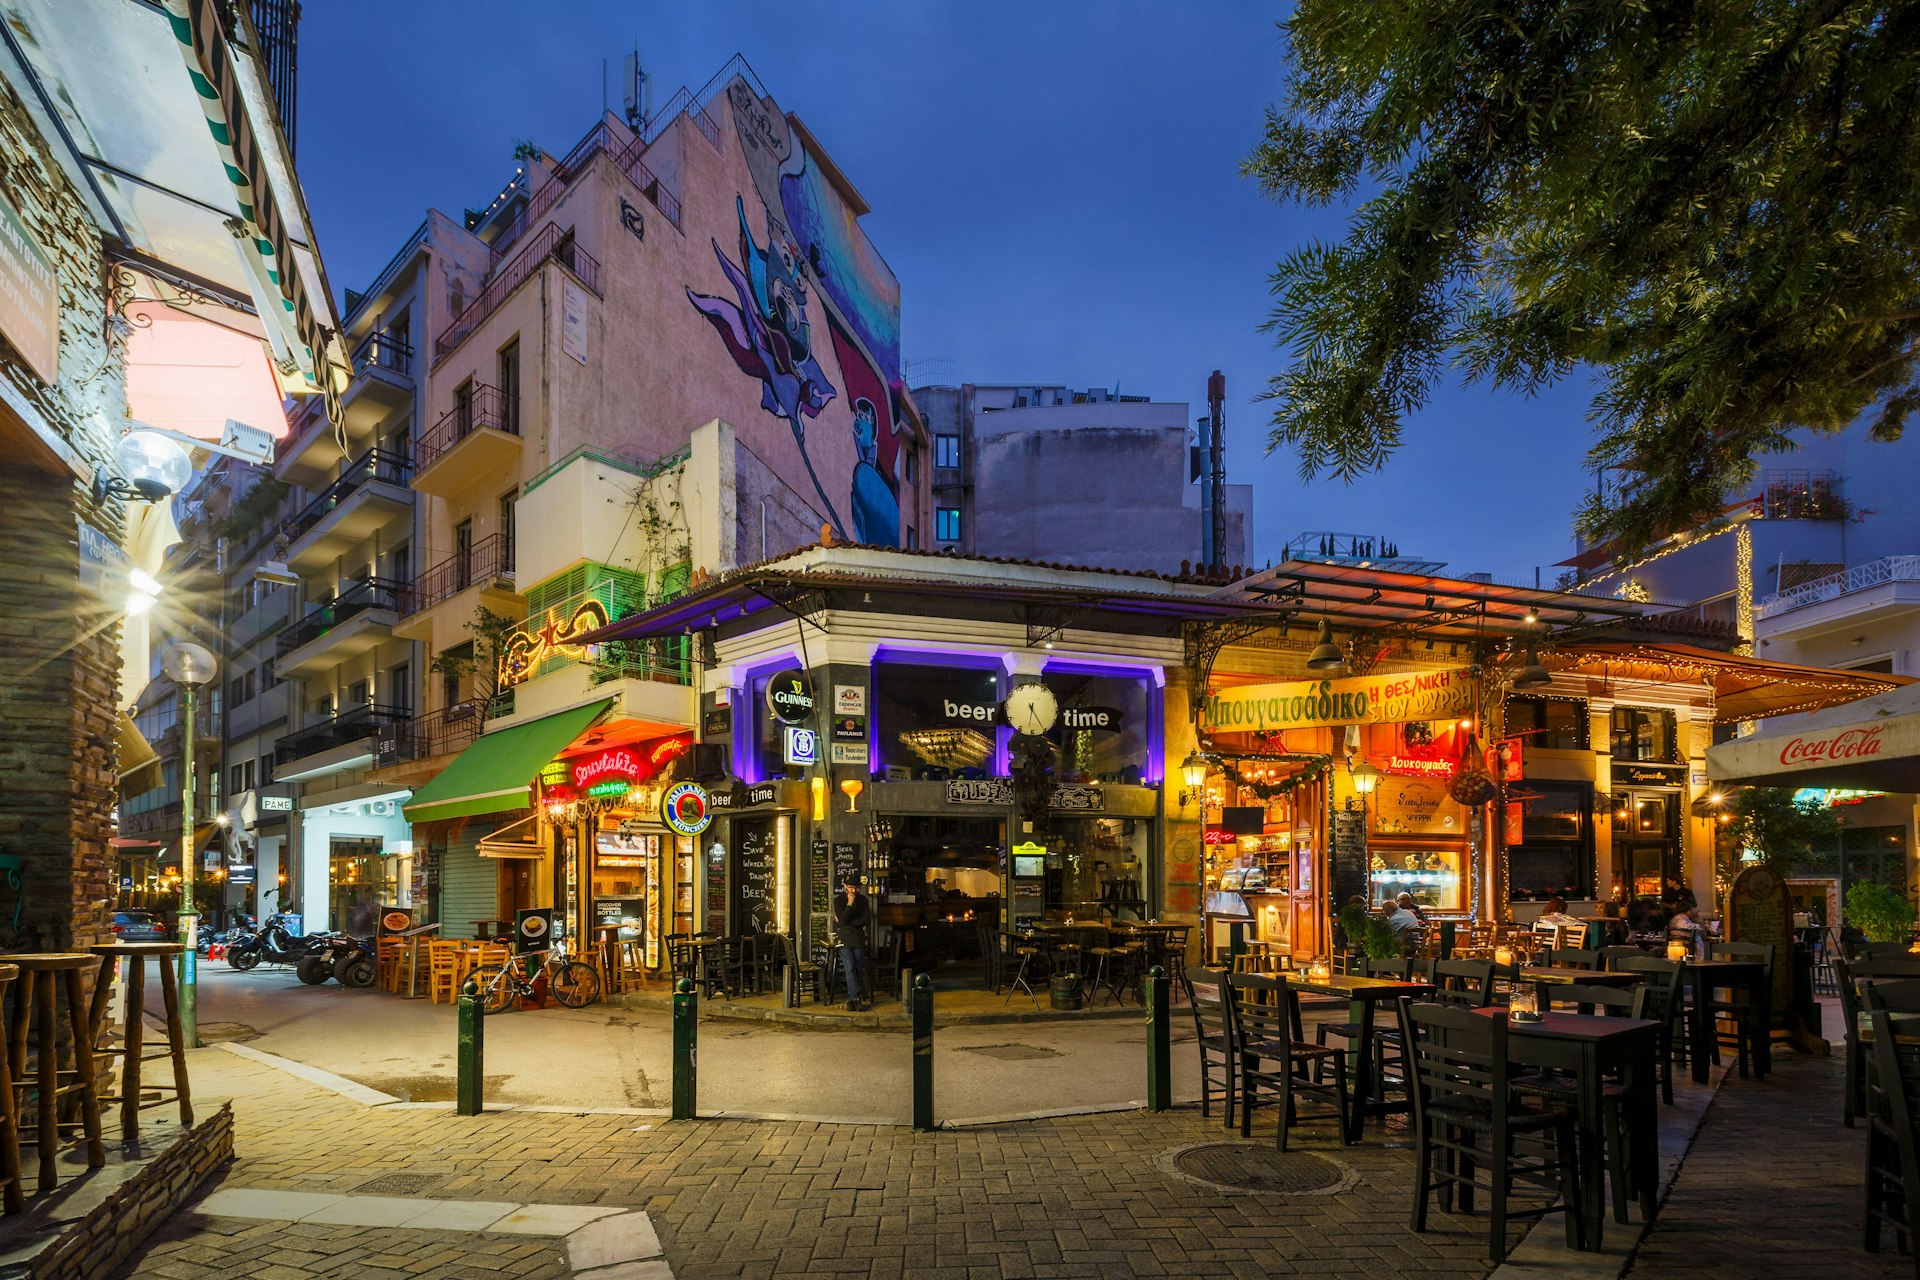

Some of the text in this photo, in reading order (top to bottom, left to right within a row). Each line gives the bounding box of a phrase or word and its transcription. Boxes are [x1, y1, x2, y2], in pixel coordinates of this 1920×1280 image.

[775, 691, 813, 708] GUINNESS
[1202, 671, 1450, 729] Μπουγατσάδικο Η ΘΕΣ/ΝΙΚΗ
[1367, 684, 1474, 723] ΣΤΟΥ ΨΥΡΡΗ
[944, 700, 1110, 727] beer time
[1780, 726, 1884, 765] Coca-Cola
[711, 789, 773, 806] beer time
[742, 884, 766, 899] BEER
